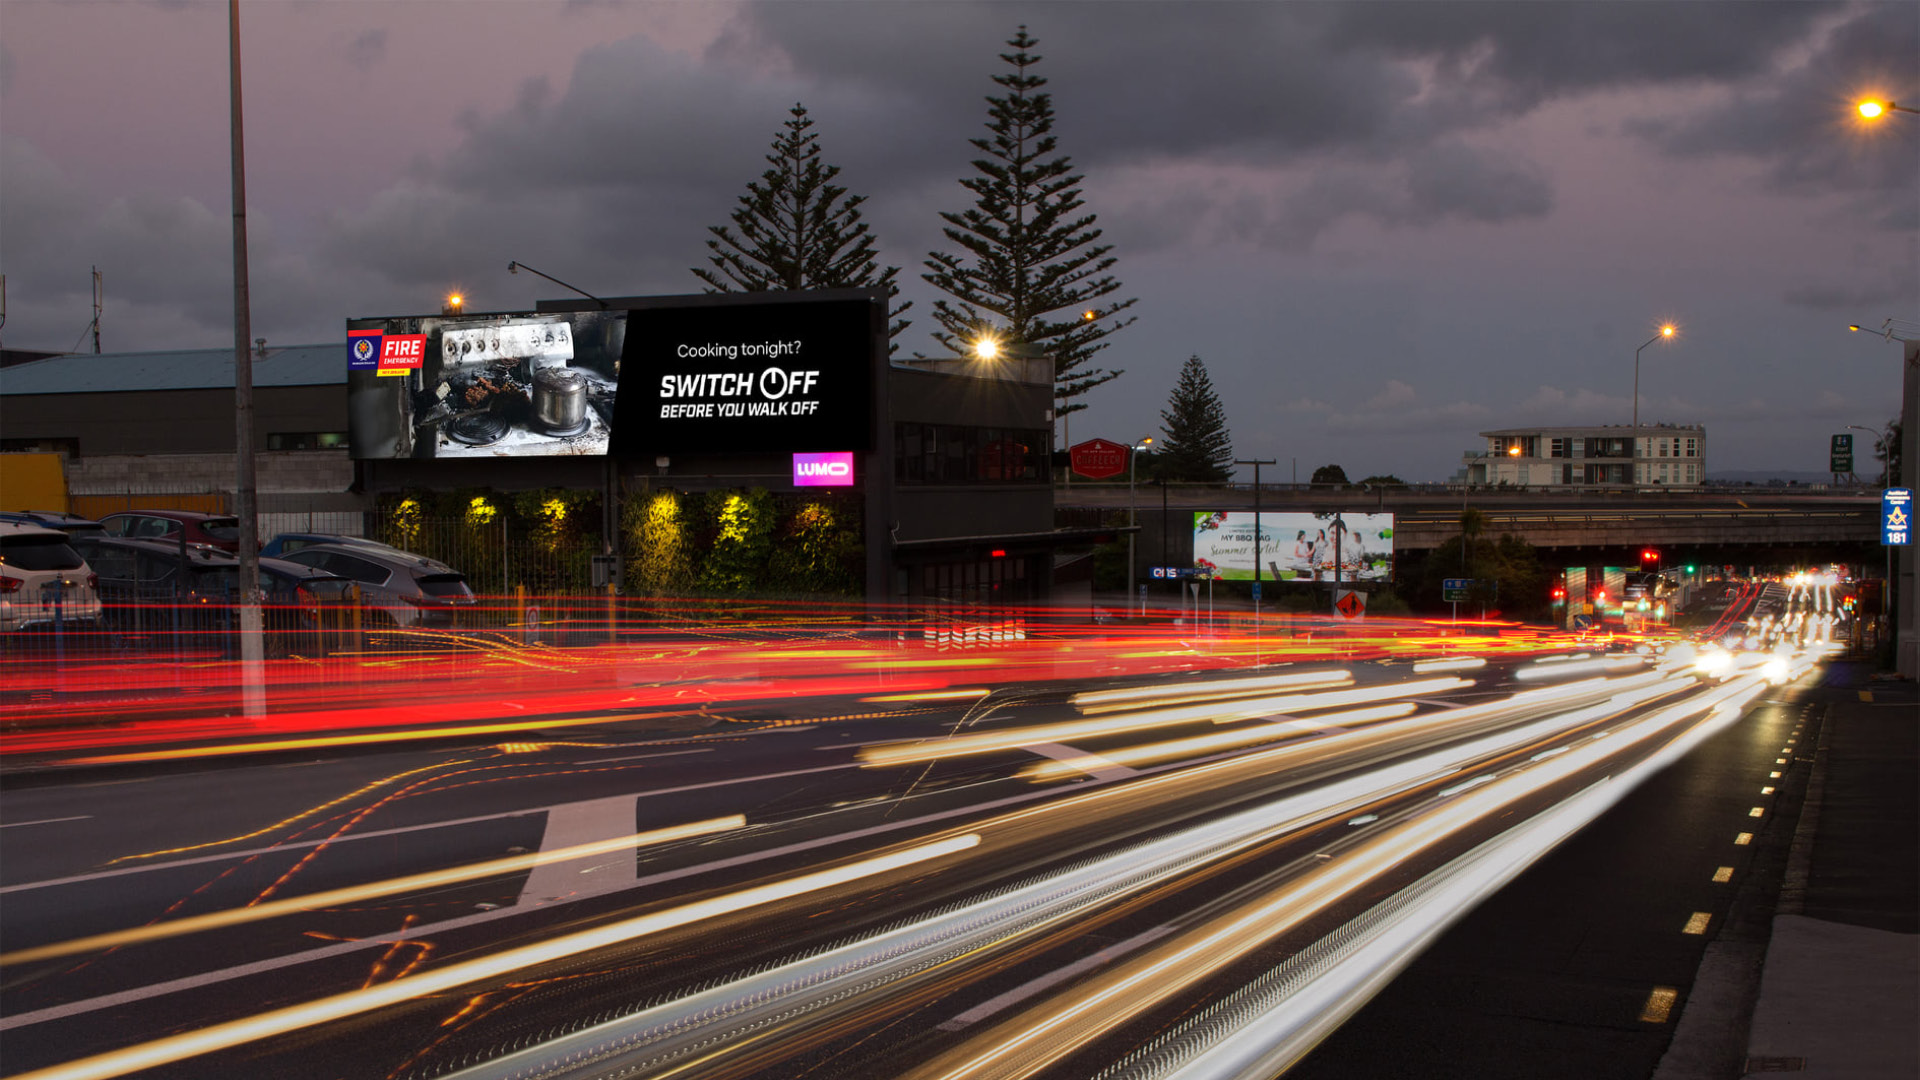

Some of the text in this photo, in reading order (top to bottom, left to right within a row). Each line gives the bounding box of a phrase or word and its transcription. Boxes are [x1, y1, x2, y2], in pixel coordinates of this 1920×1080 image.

[385, 340, 421, 356] FIRE
[677, 340, 802, 360] Cooking tonight?
[383, 357, 419, 365] EMERGENCY
[659, 373, 754, 398] SWITCH
[660, 401, 820, 418] BEFORE YOU WALK OFF
[797, 462, 849, 476] LUMO
[1235, 534, 1252, 542] BBQ
[1255, 534, 1271, 542] AG
[1887, 532, 1907, 544] 181
